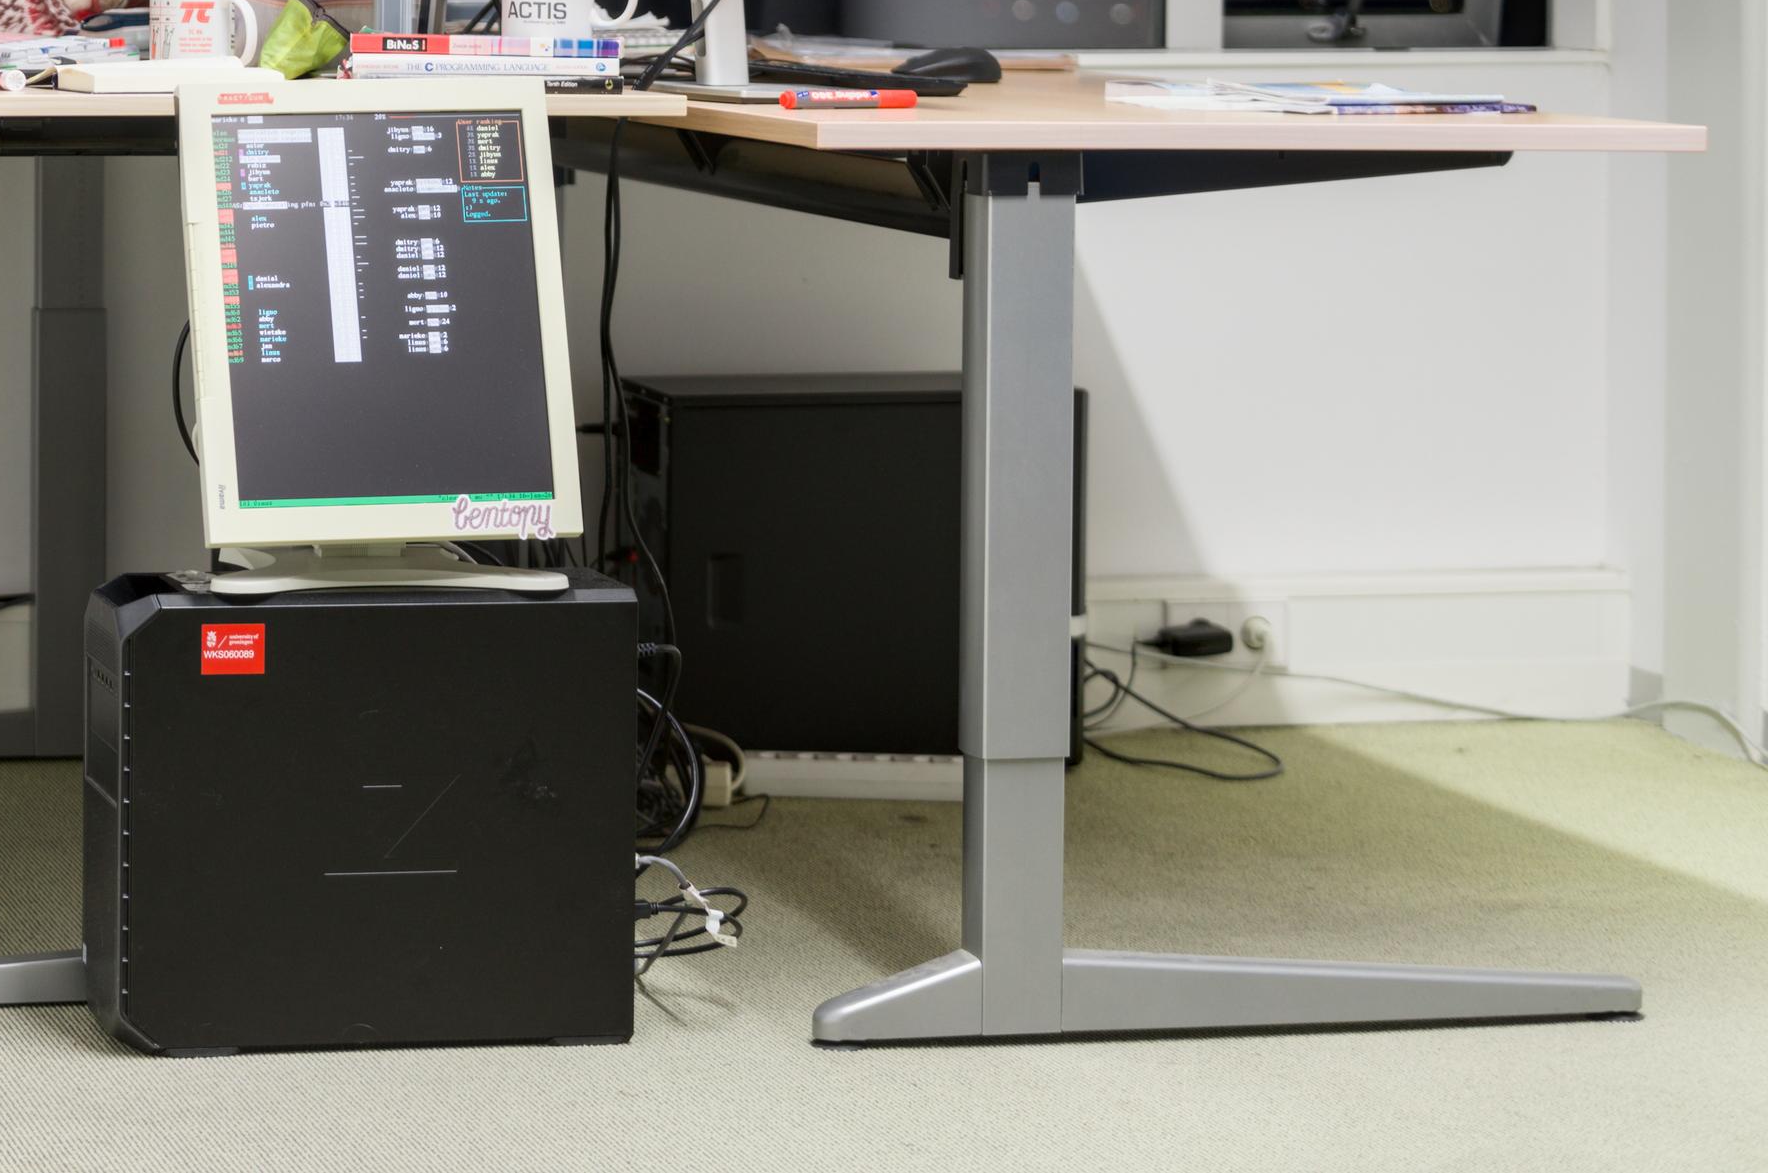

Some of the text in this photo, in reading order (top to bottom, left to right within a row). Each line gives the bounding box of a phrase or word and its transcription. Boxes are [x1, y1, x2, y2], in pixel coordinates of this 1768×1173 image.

[508, 1, 567, 19] ACTIS
[424, 62, 434, 72] C
[435, 62, 501, 71] PROGRAMMING
[504, 62, 549, 71] LANGUAGE
[561, 80, 578, 88] Edition
